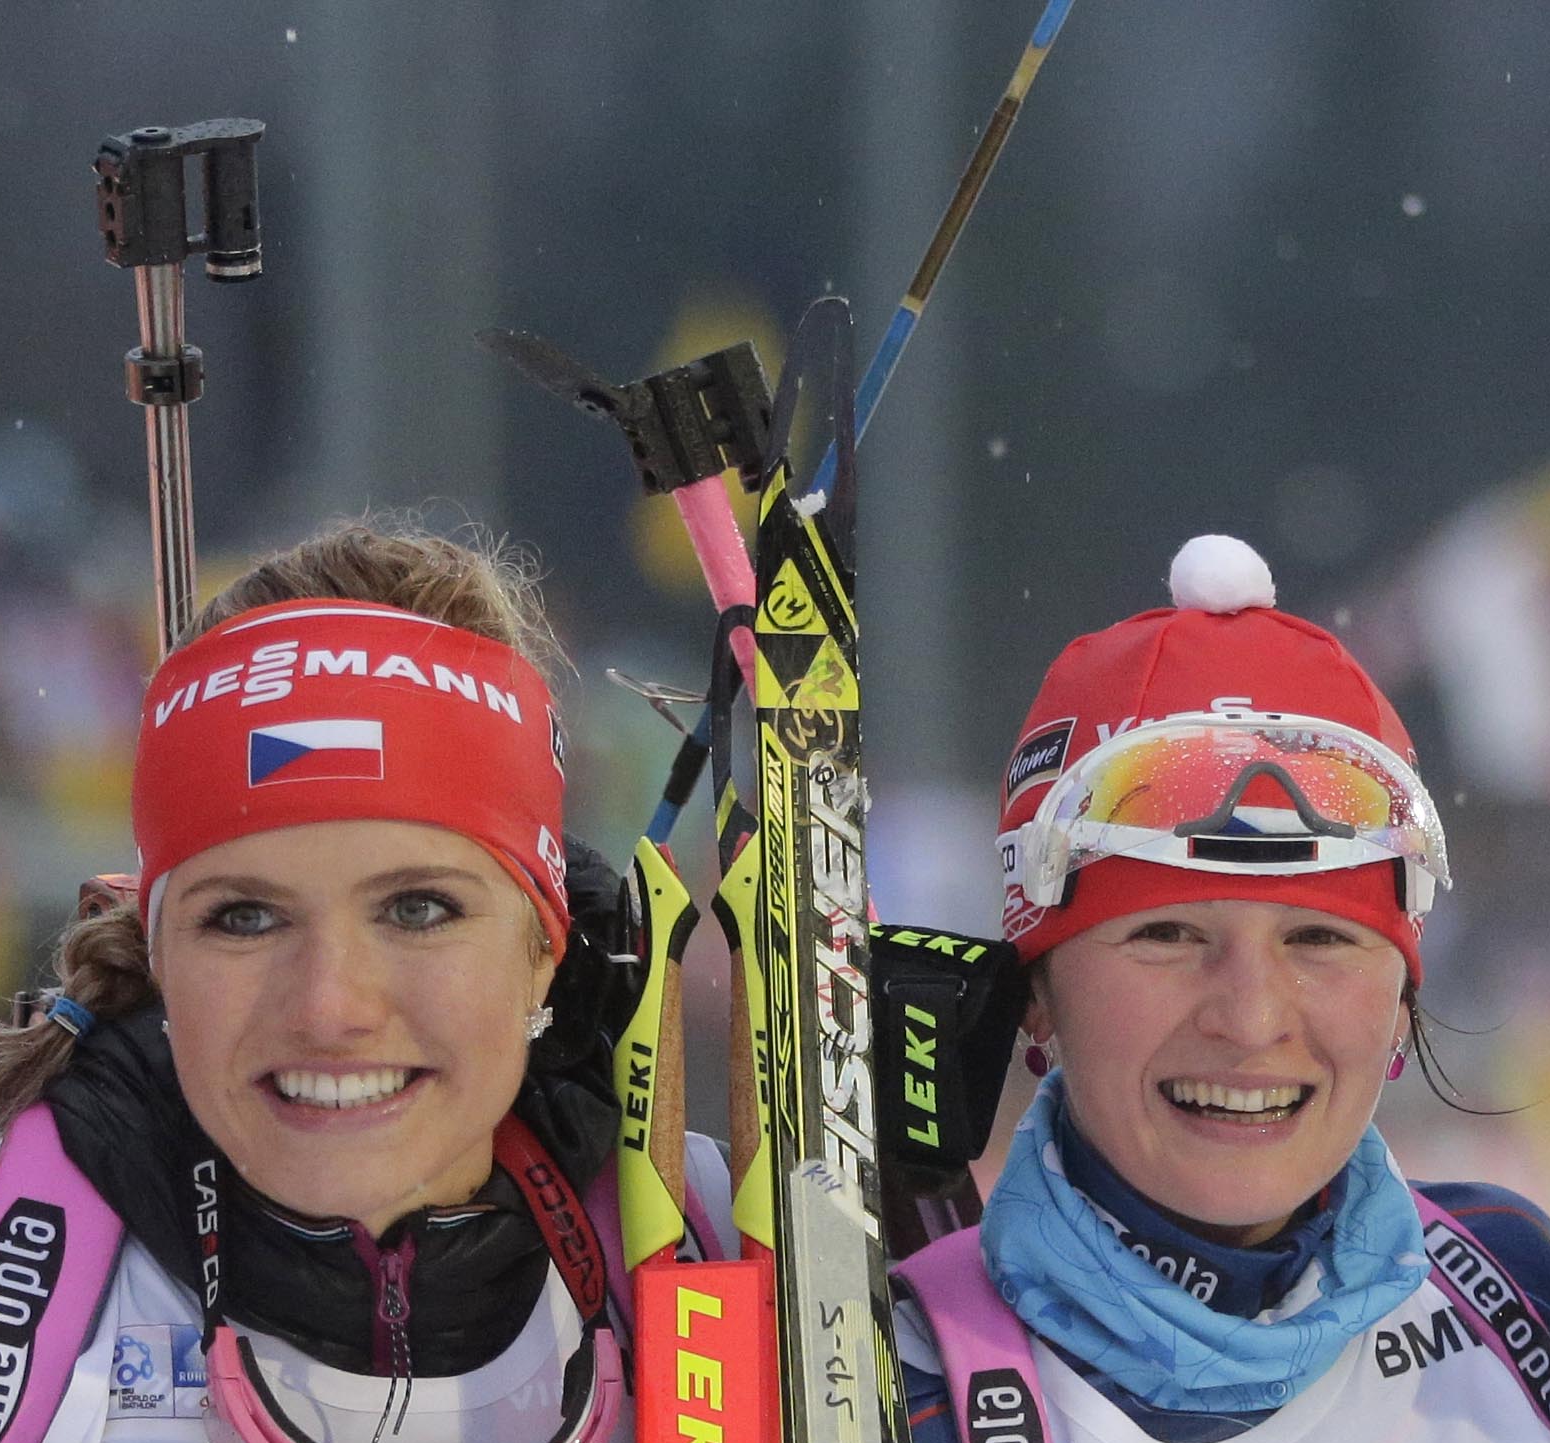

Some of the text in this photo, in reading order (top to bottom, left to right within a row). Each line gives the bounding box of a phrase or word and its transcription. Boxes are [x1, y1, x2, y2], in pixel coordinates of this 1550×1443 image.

[155, 641, 522, 729] VIESSMANN
[1008, 738, 1063, 786] Hamé
[623, 1041, 653, 1152] LEKI
[904, 1003, 940, 1148] LEKI
